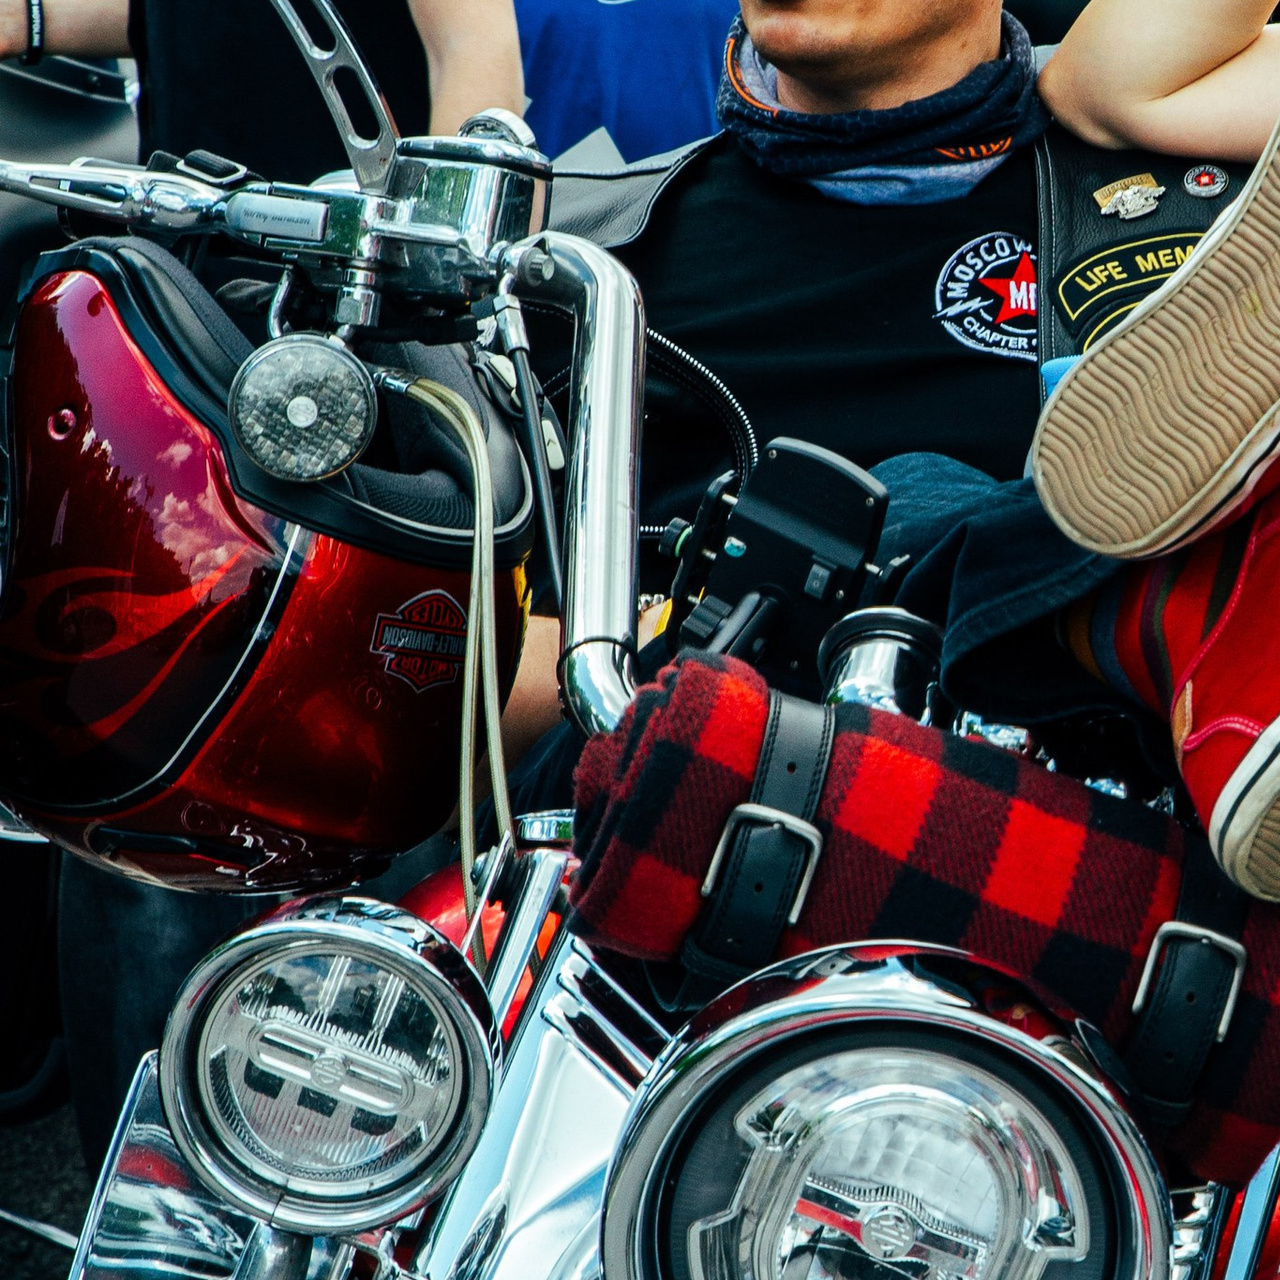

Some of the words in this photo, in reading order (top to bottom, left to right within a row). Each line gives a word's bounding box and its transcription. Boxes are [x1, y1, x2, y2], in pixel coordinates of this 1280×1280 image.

[946, 237, 1033, 298] MOSCOW
[1074, 260, 1128, 292] LIFE
[962, 315, 1029, 350] CHAPTER
[410, 600, 458, 628] CYCLES
[382, 625, 468, 658] ARLEY-DAVIDSON
[400, 656, 449, 680] MOTOR
